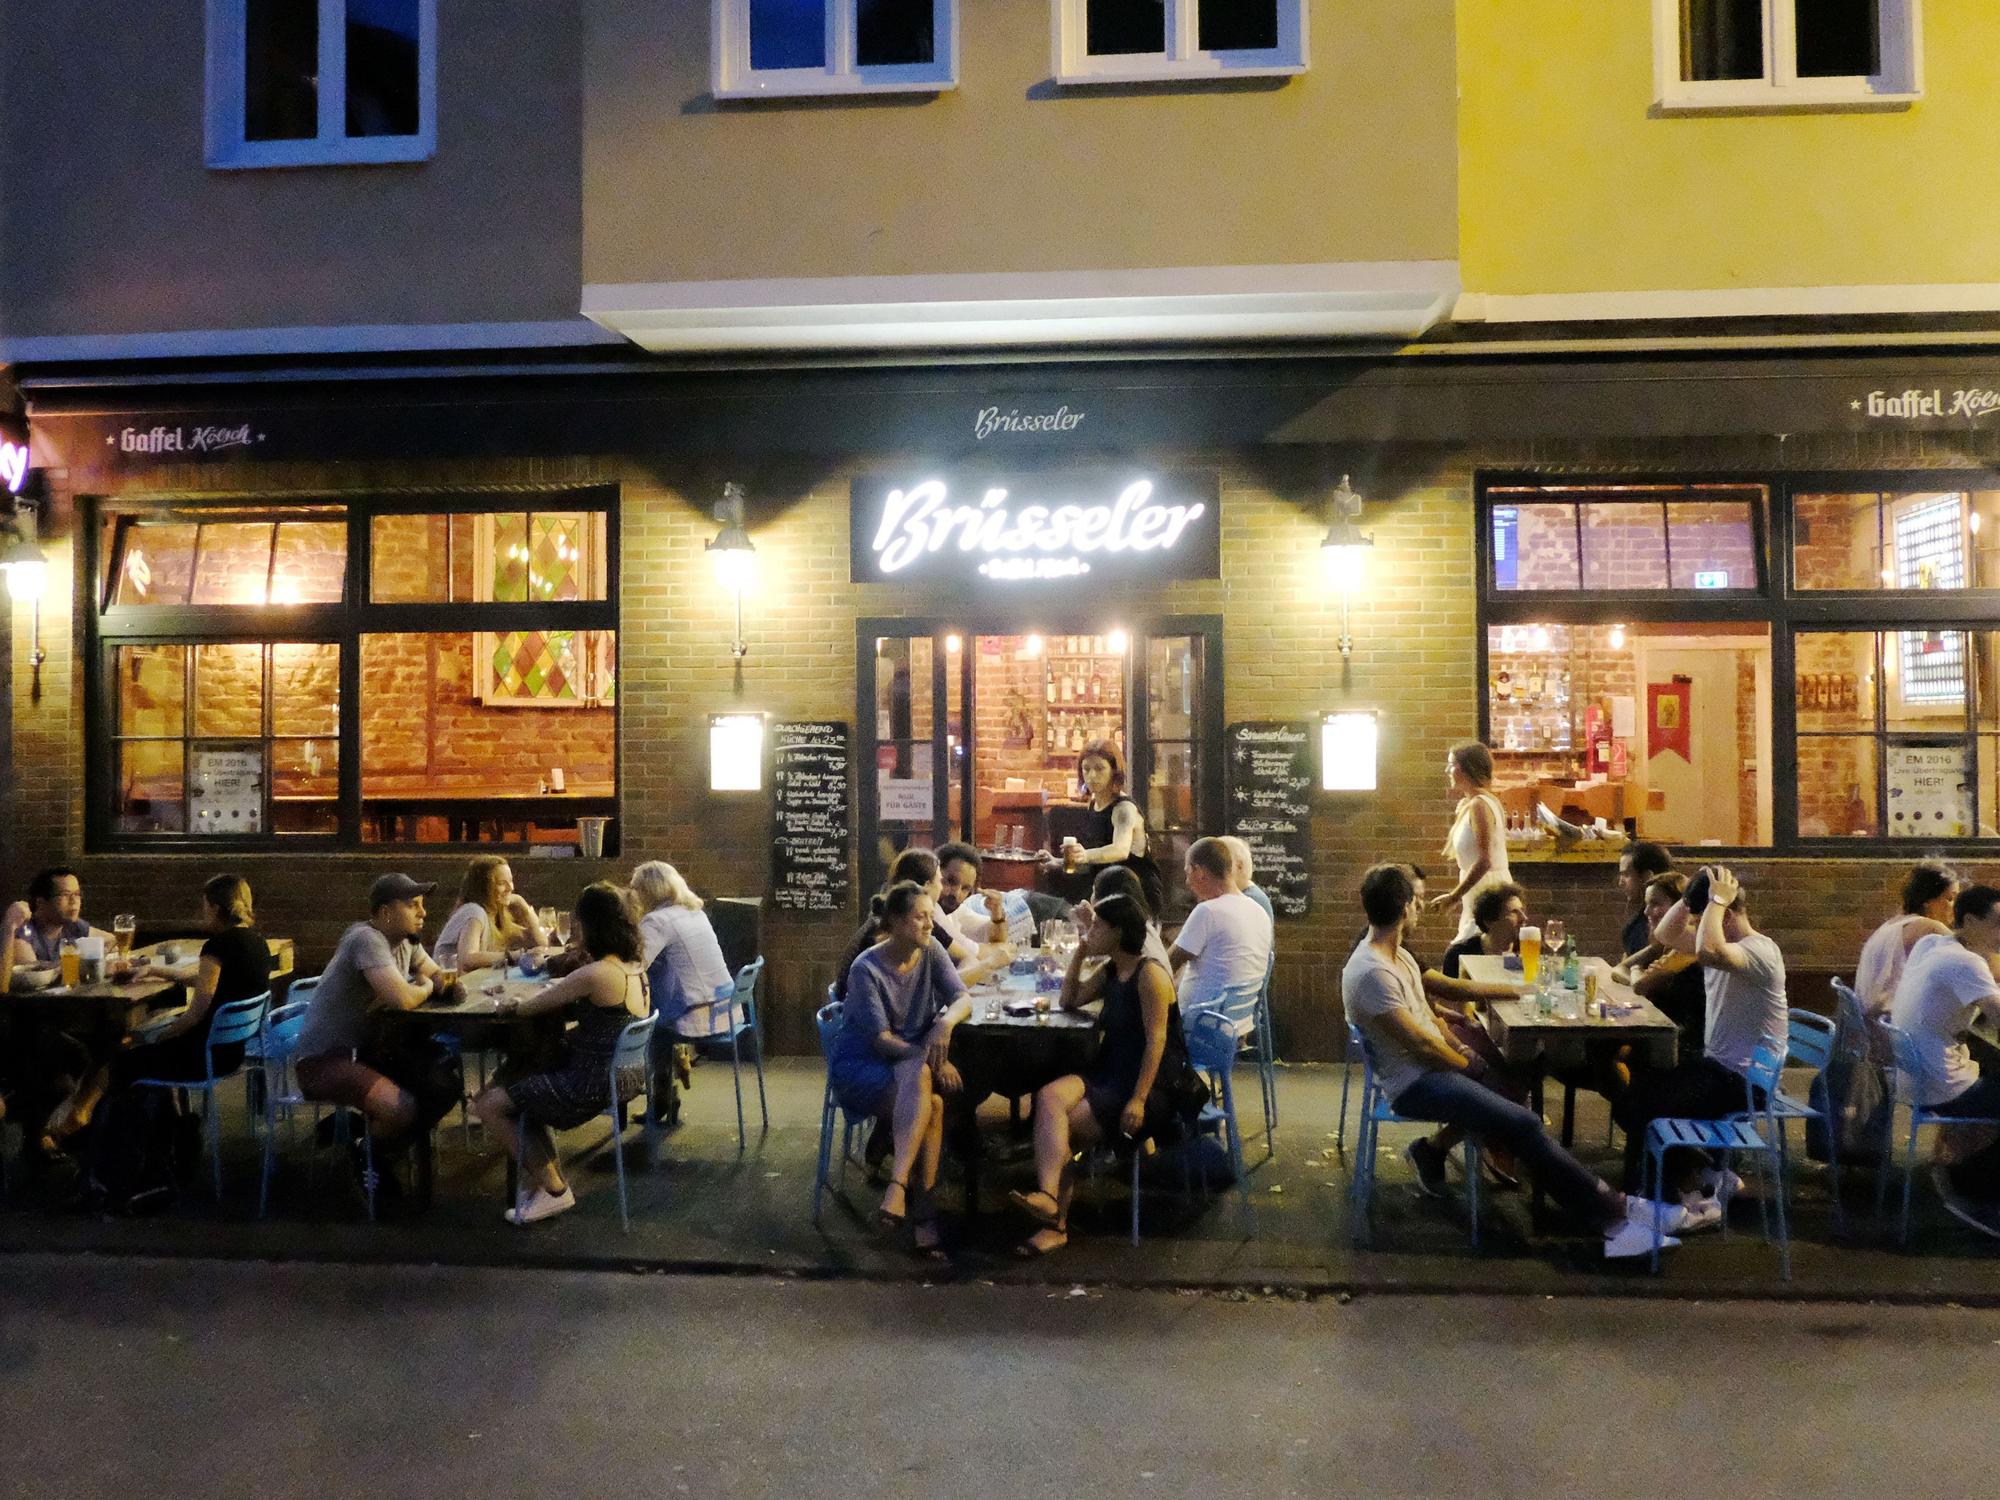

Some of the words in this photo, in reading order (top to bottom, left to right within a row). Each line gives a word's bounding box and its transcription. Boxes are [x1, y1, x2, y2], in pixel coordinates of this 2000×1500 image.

[1868, 389, 1944, 418] Gaffel
[1948, 388, 2000, 417] Köls
[974, 405, 1085, 440] Brüsseler
[121, 426, 183, 453] Gaffel
[873, 480, 1205, 573] Brüsseler
[1905, 755, 1923, 764] EM
[1927, 755, 1952, 764] 2016
[1913, 777, 1944, 786] HIER!
